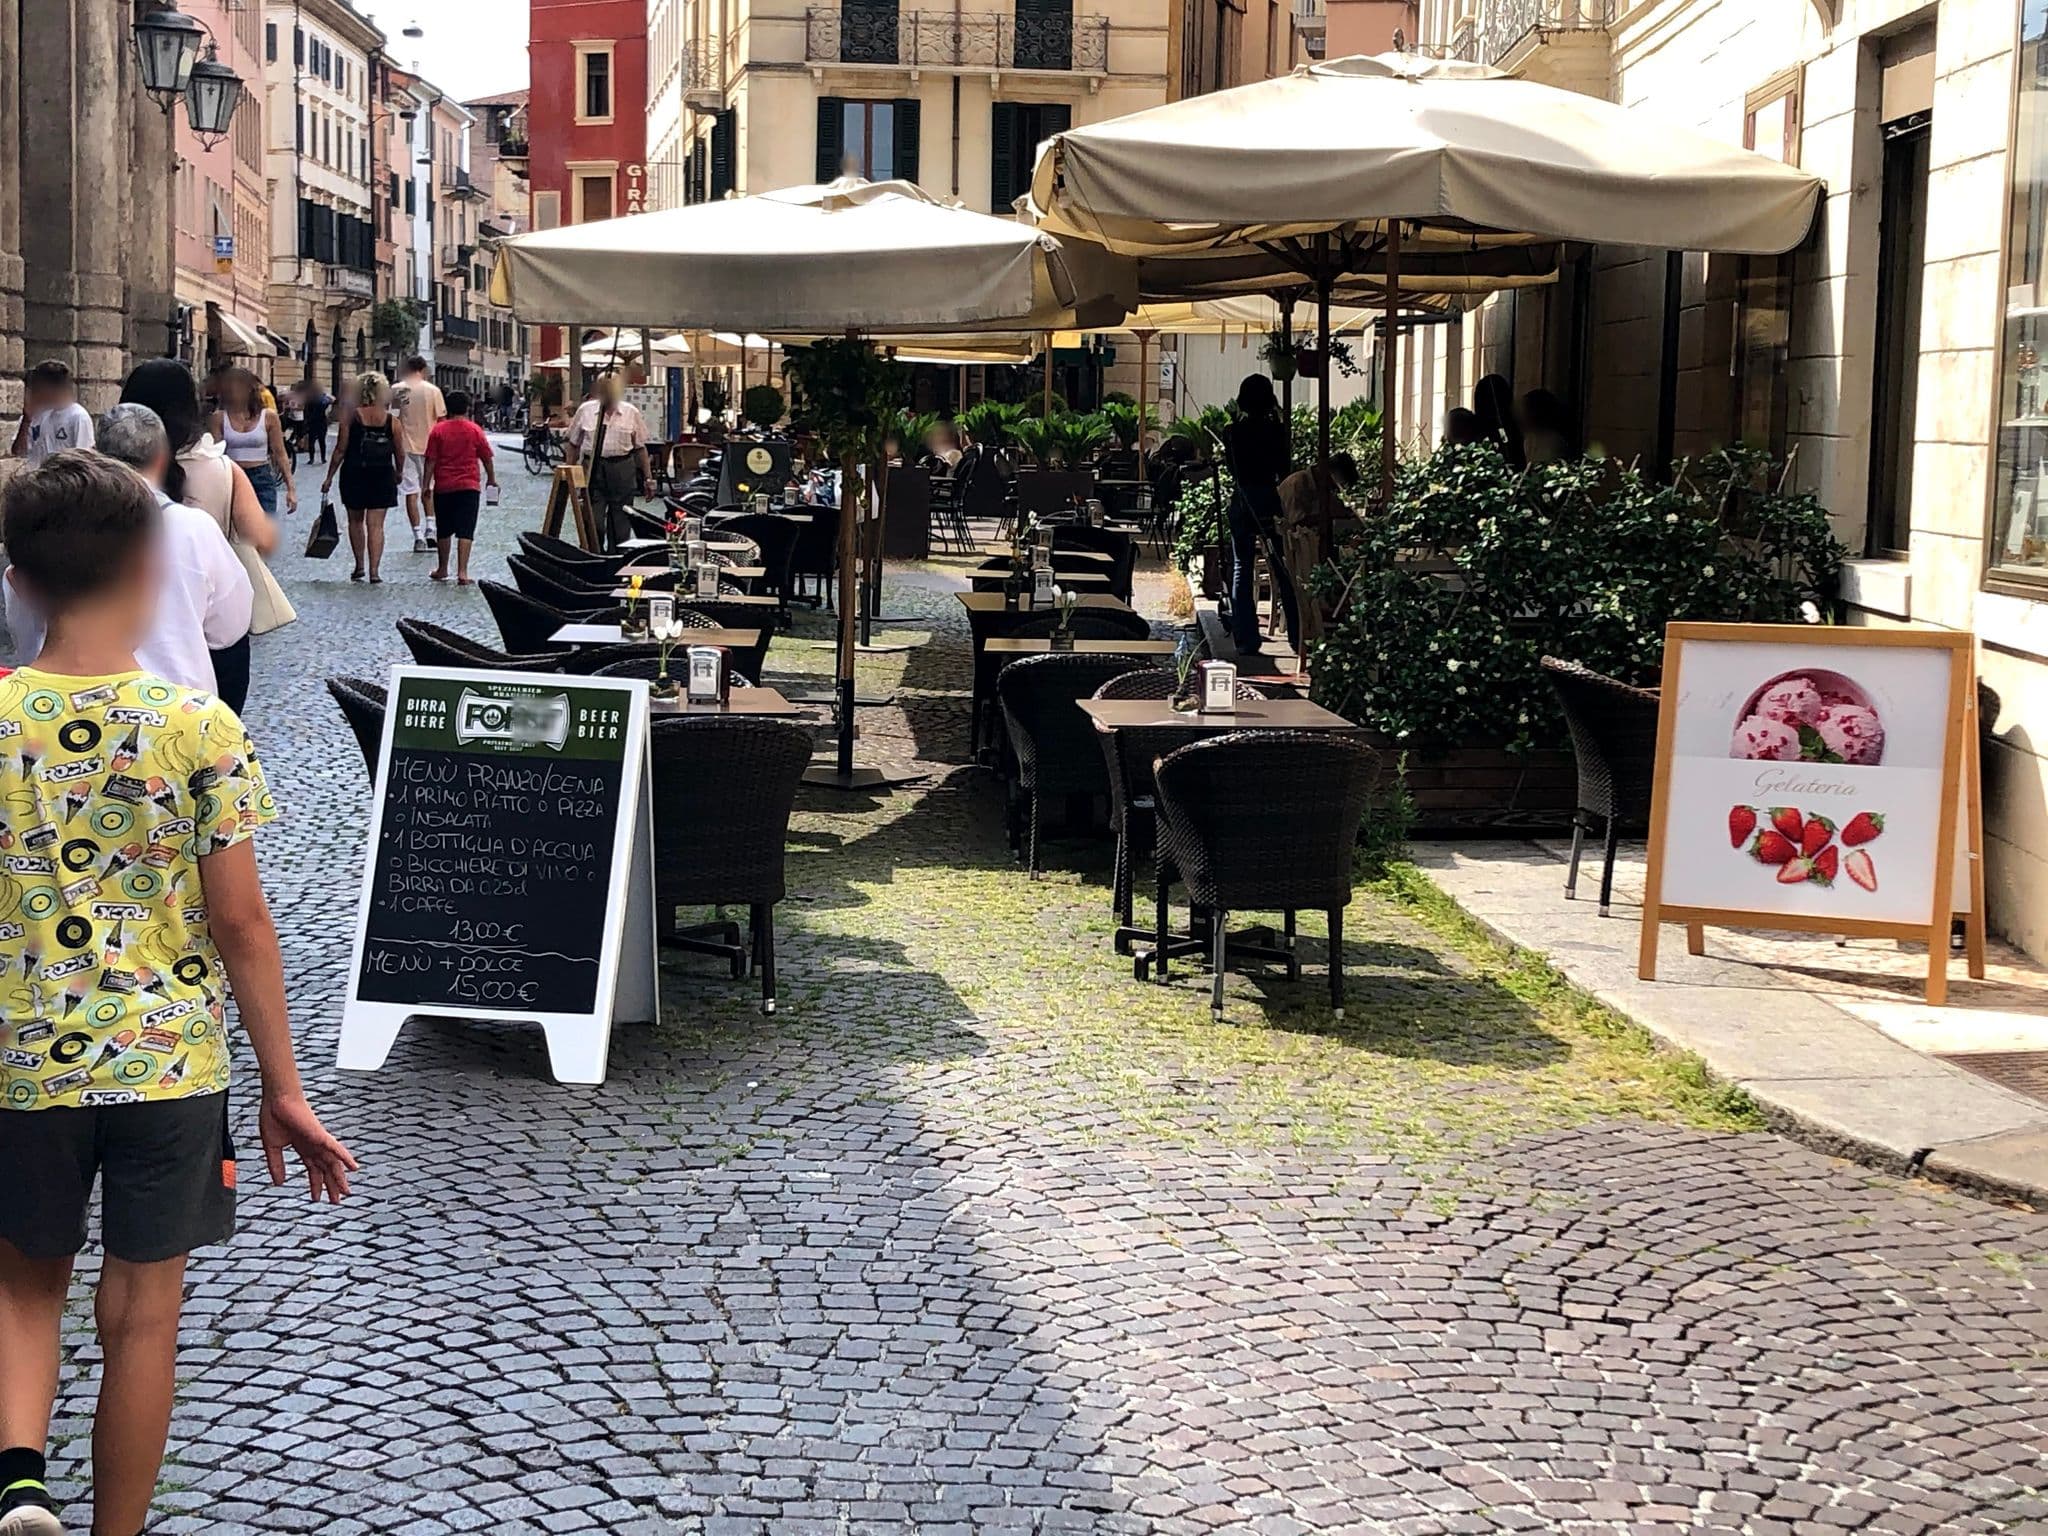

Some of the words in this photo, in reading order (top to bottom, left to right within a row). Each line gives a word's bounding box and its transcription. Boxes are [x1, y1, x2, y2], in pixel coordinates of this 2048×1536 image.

[626, 165, 642, 216] GIRA
[407, 699, 447, 713] BIRRA
[405, 712, 445, 729] BIÈRE
[580, 709, 620, 724] BEER
[578, 725, 618, 739] BIER
[1752, 768, 1857, 797] Gelateria
[558, 796, 604, 818] PIZZA
